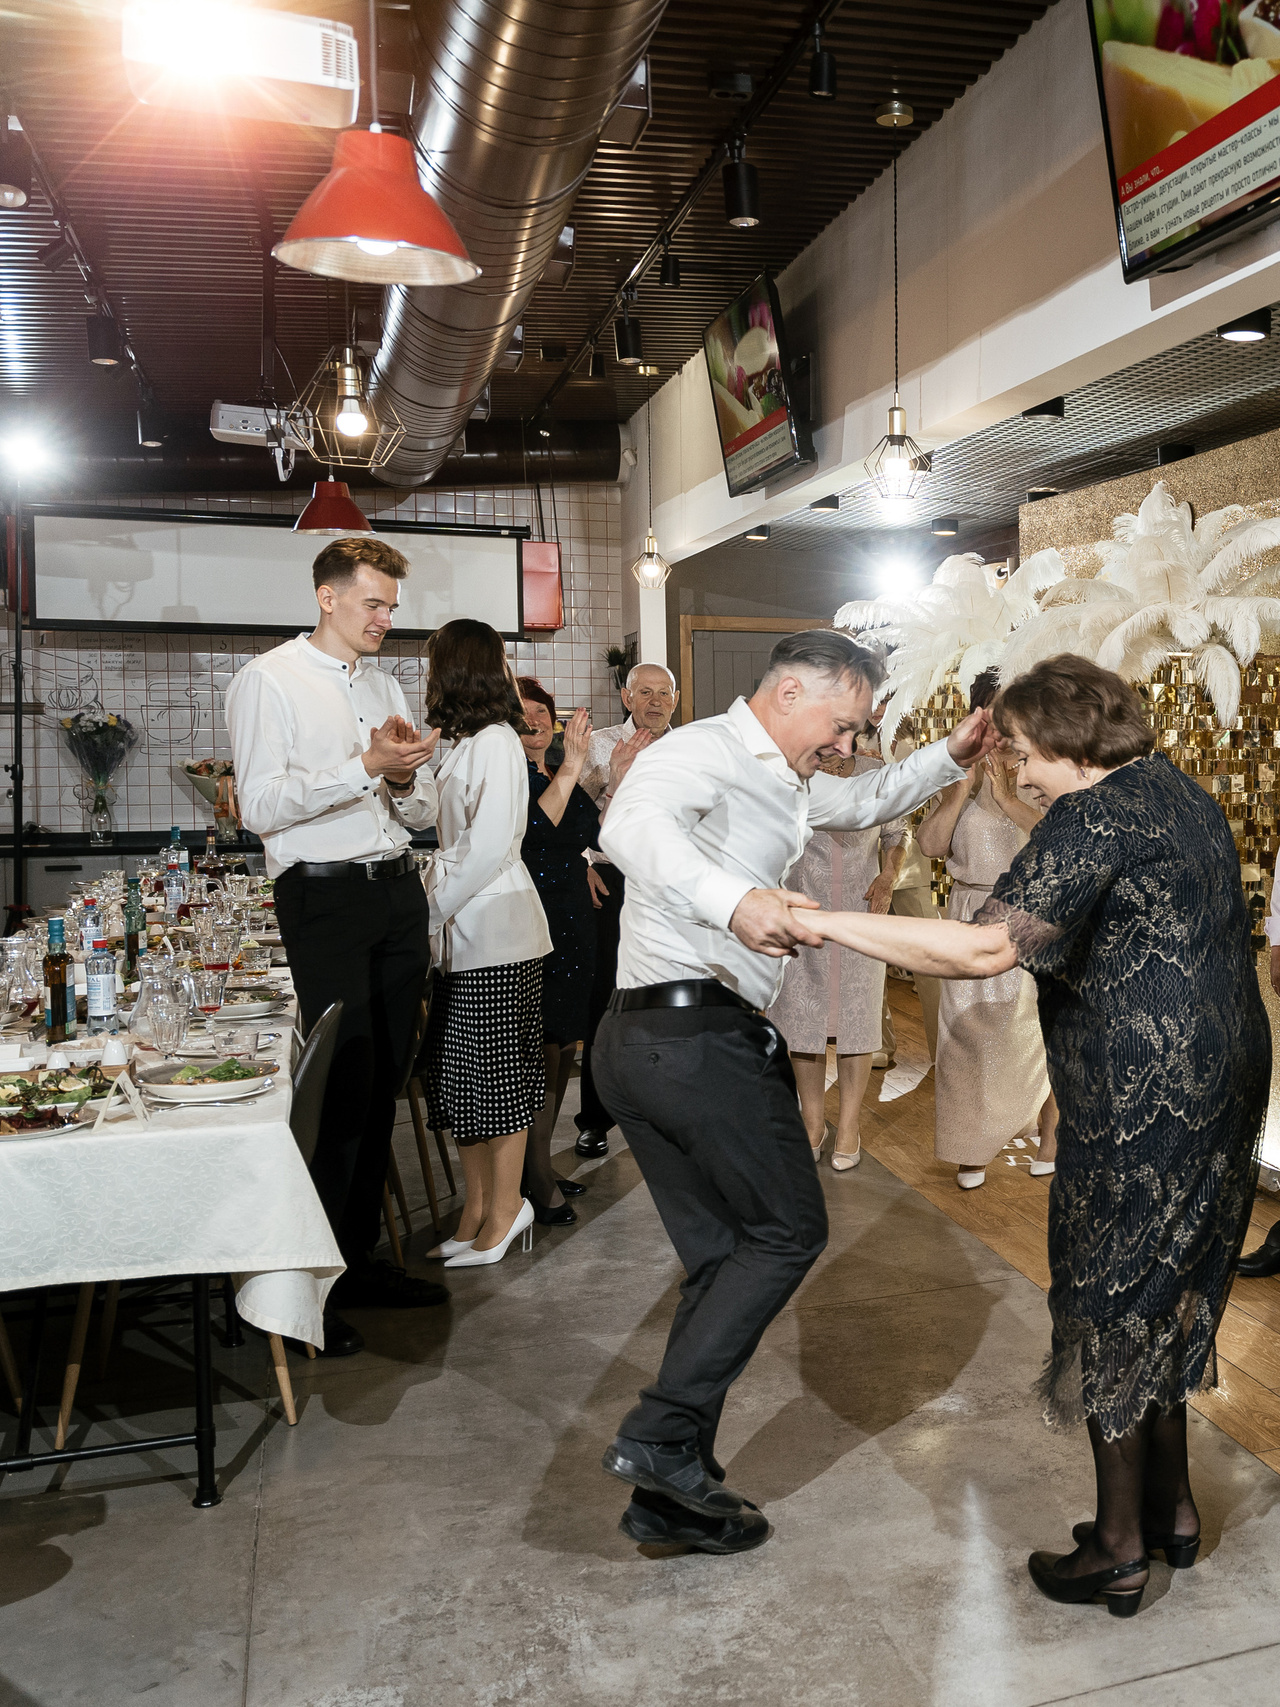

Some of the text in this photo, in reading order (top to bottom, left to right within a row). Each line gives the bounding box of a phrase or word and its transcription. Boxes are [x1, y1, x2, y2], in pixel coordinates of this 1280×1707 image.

[1190, 153, 1217, 176] открытые
[1217, 125, 1262, 160] мастер-классы
[1268, 114, 1280, 128] мы
[1121, 186, 1126, 197] А
[1125, 182, 1133, 194] Вы
[1126, 218, 1143, 234] нашем
[1143, 208, 1156, 224] кафе
[1180, 189, 1192, 202] Они
[1193, 179, 1207, 197] дают
[1208, 159, 1242, 188] прекрасную
[1145, 233, 1150, 242] а
[1150, 227, 1160, 240] вам
[1165, 215, 1183, 234] узнать
[1183, 204, 1200, 221] новые
[1200, 190, 1224, 214] рецепты
[1225, 188, 1230, 197] и
[1230, 175, 1251, 195] просто
[1251, 160, 1278, 182] отлично
